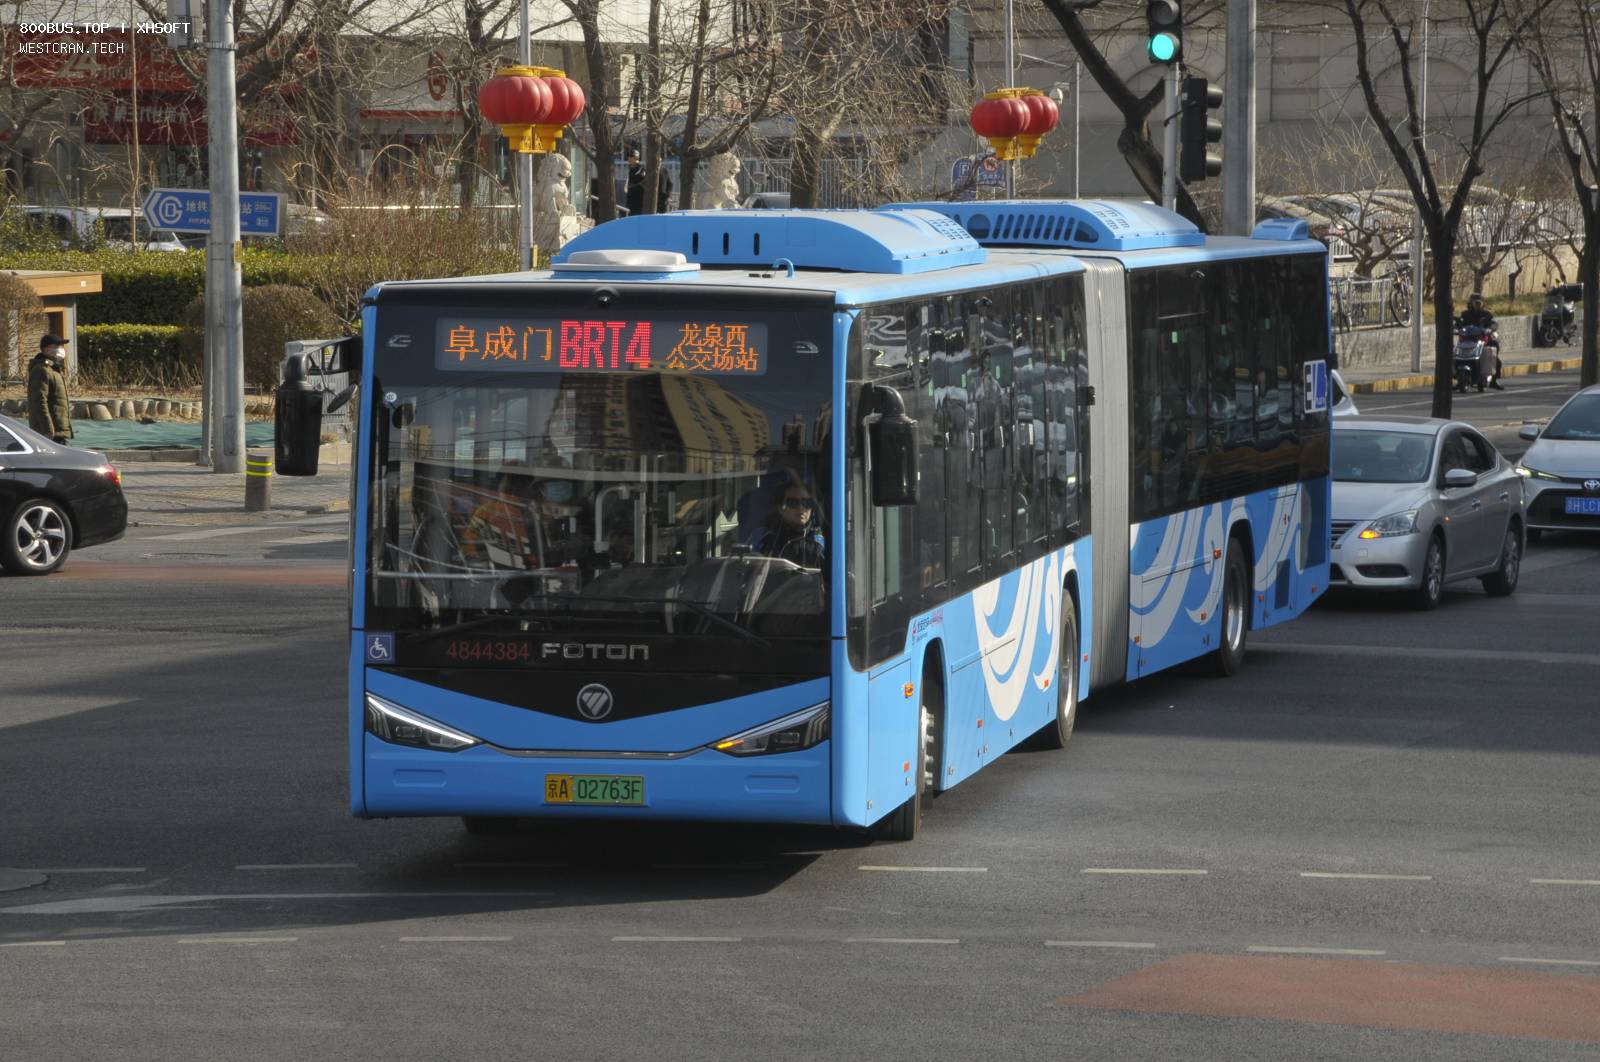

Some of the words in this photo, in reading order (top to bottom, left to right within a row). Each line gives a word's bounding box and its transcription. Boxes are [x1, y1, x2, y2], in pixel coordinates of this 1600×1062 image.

[445, 325, 553, 361] 阜成门
[559, 320, 651, 368] BRT4
[677, 323, 749, 348] 龙泉西
[665, 345, 759, 371] 公交场站
[447, 641, 530, 660] 4844384
[577, 779, 641, 800] 02763F
